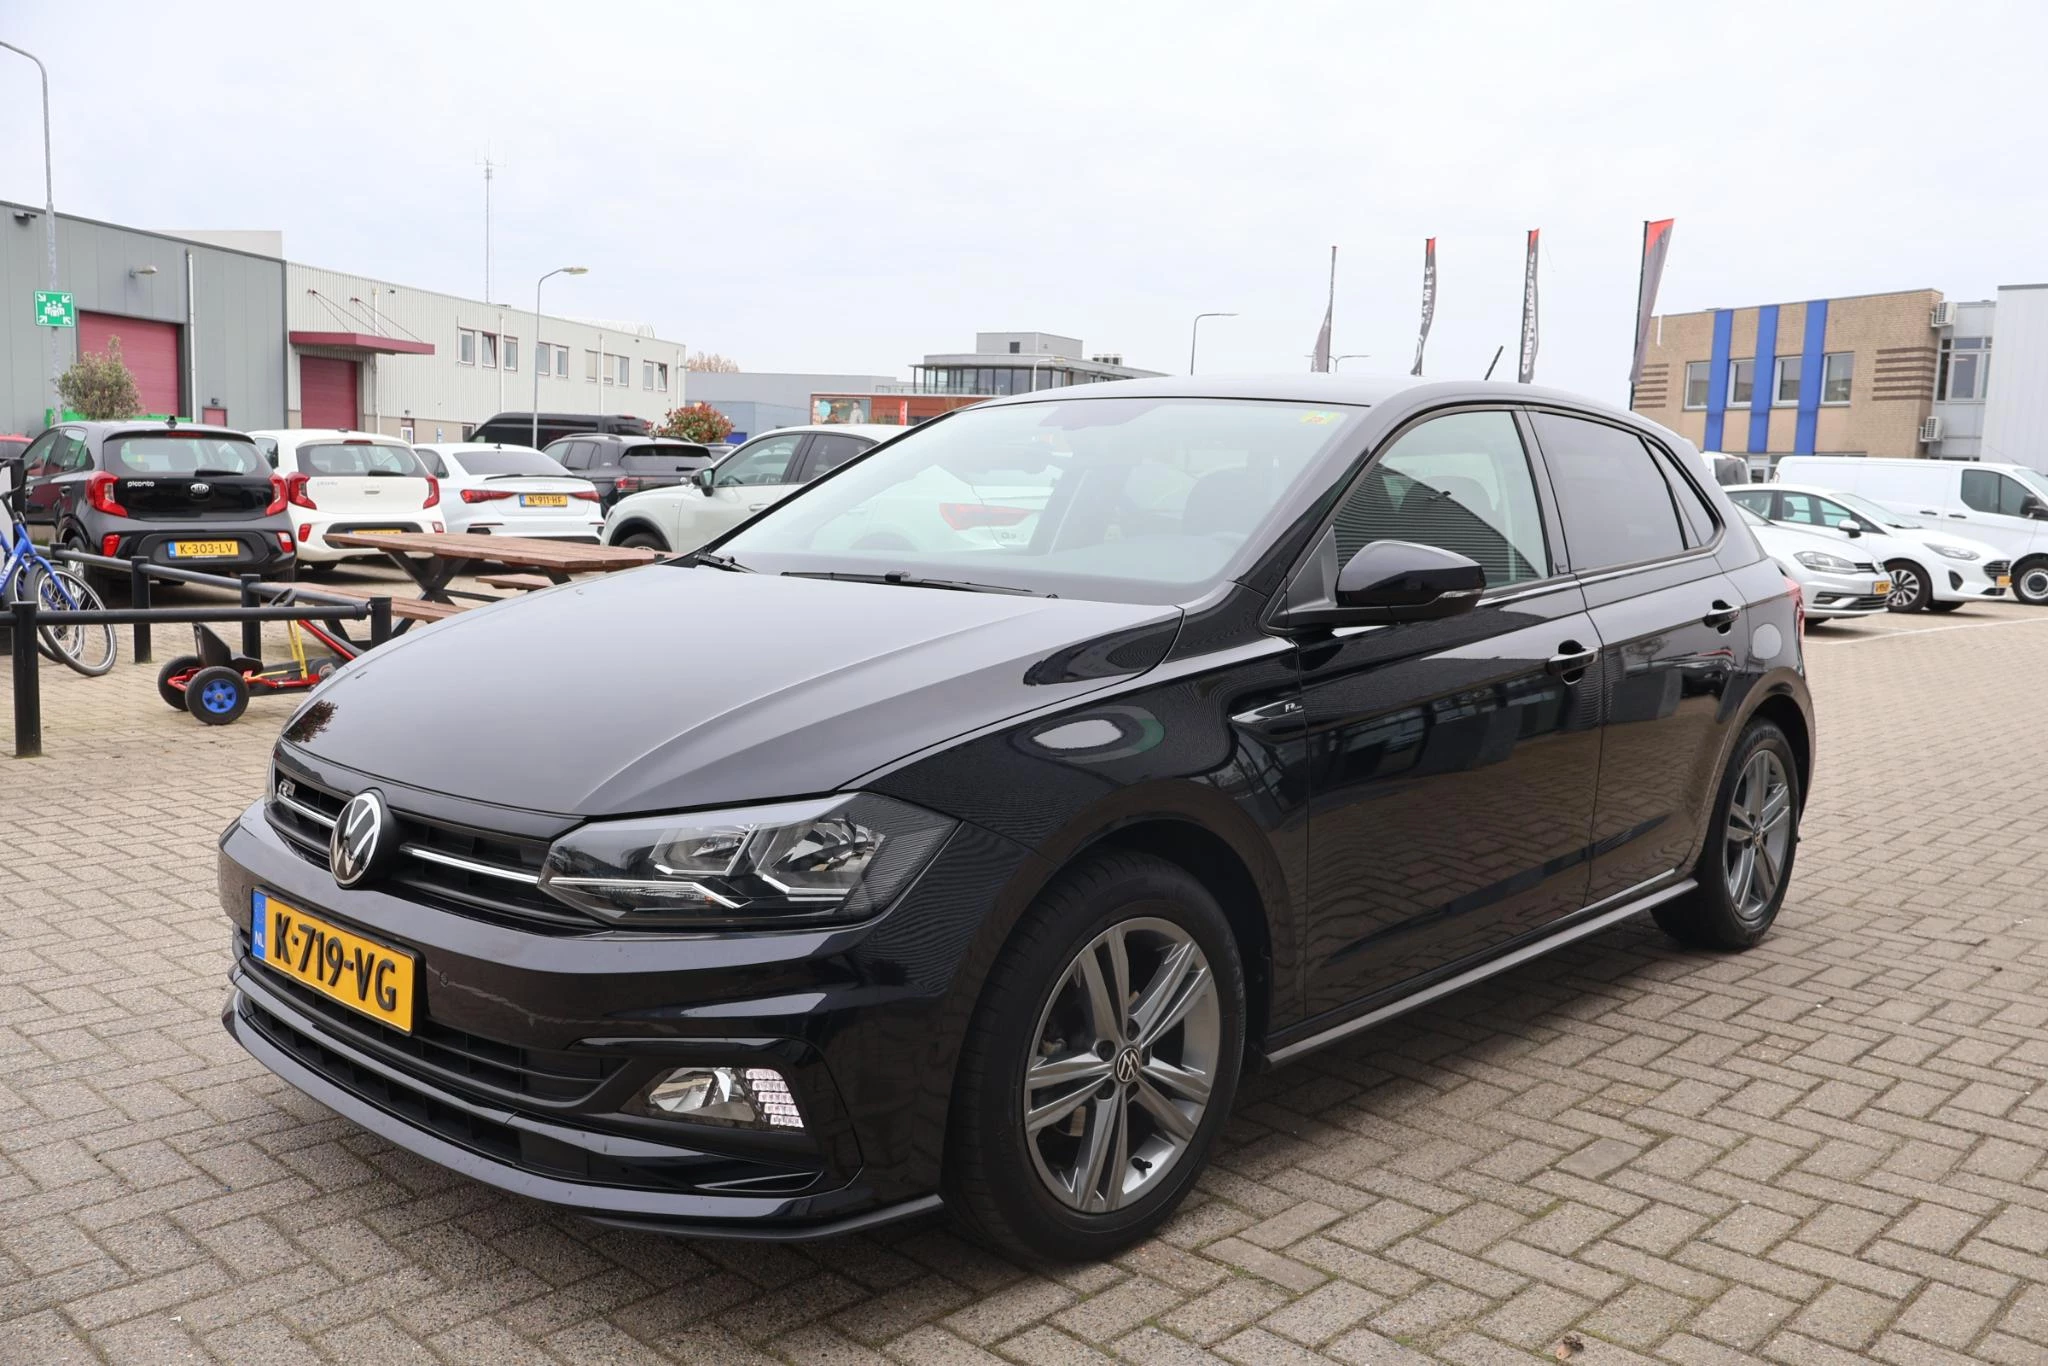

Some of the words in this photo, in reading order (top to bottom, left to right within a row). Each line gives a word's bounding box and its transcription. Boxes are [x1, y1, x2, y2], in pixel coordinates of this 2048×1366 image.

[179, 543, 233, 555] K-303-LV
[254, 930, 265, 948] NL
[274, 911, 397, 1012] K-719-VG
